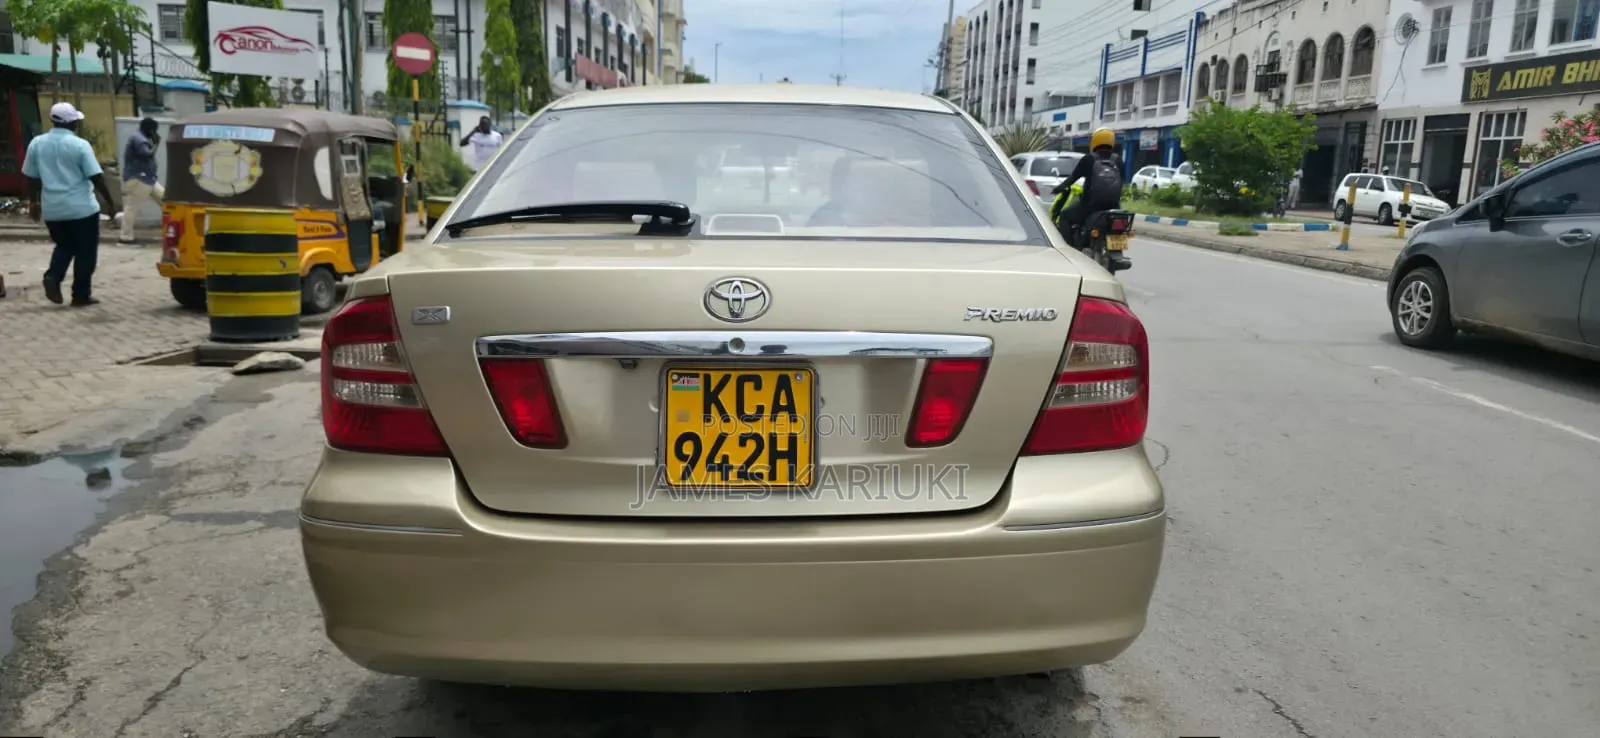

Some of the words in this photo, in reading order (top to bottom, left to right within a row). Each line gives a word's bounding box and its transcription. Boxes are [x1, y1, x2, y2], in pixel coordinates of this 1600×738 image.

[219, 35, 273, 55] Canon
[1496, 65, 1557, 91] AMIR
[1562, 60, 1600, 84] BHI
[963, 306, 1058, 323] PREMIO
[702, 373, 798, 423] KCA
[674, 431, 798, 482] 942H
